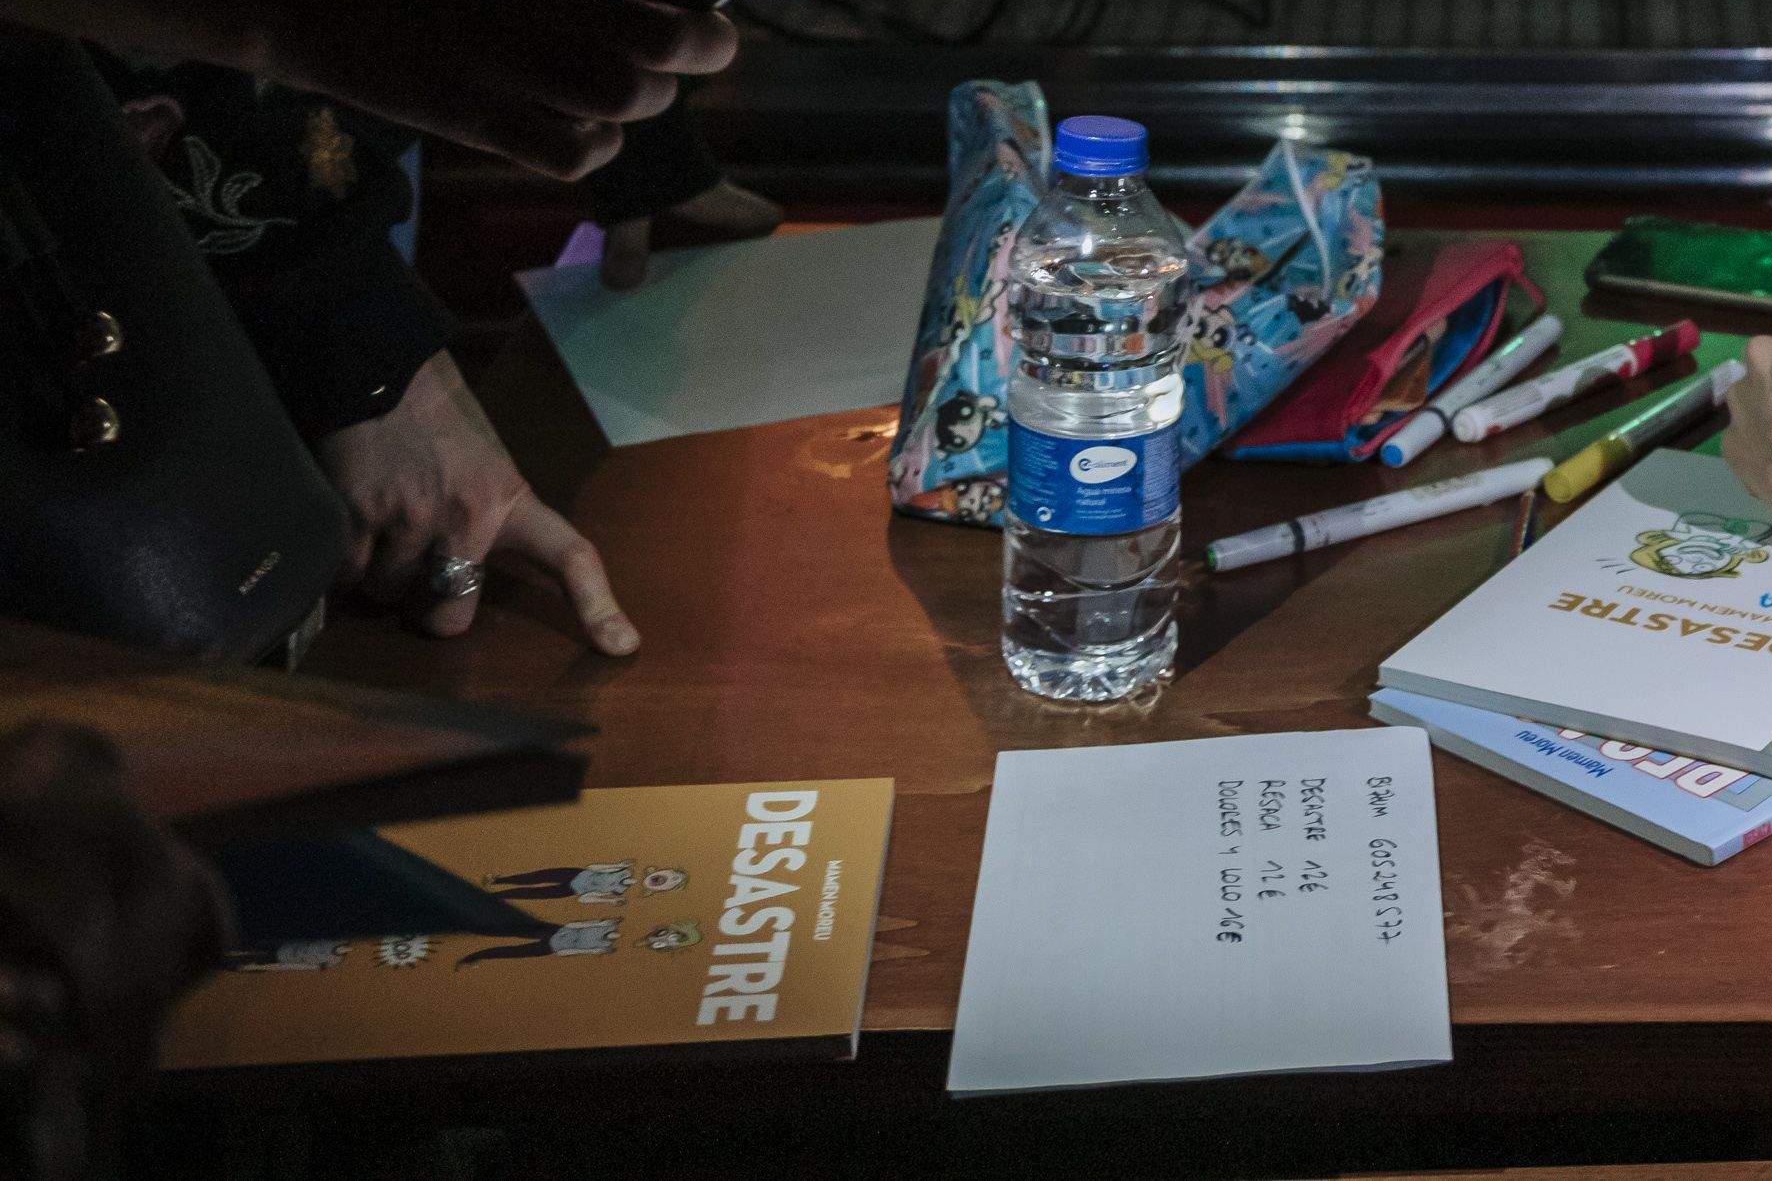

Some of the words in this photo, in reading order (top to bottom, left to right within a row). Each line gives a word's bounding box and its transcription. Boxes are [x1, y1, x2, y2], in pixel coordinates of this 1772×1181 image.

[1616, 584, 1698, 608] MOREU
[1515, 729, 1563, 759] Moreu
[1560, 747, 1615, 779] Mamen
[1217, 780, 1245, 837] DOLORES
[1257, 779, 1287, 831] RESACA
[1300, 777, 1328, 841] DESASTRE
[820, 859, 843, 900] MAMEN
[1220, 868, 1243, 902] LOLO
[696, 790, 819, 1026] DESASTRE
